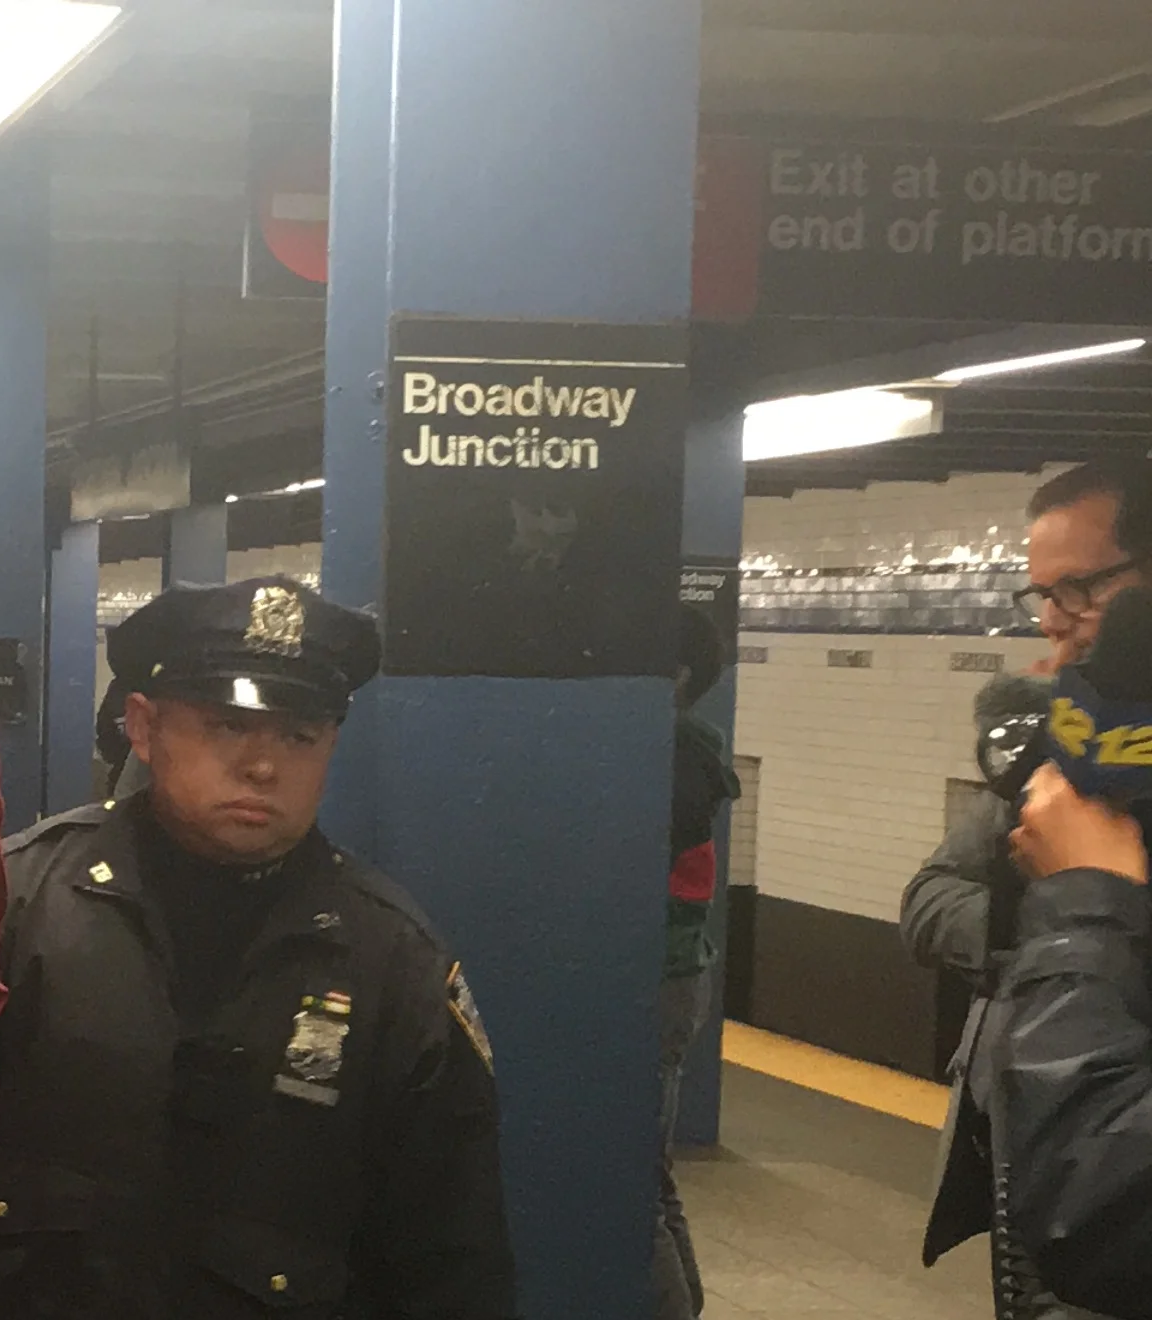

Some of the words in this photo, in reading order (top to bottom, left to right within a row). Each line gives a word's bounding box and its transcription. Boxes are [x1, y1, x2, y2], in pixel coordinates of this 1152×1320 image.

[769, 147, 870, 197] Exit
[892, 157, 941, 198] at
[964, 157, 1101, 205] other
[767, 205, 866, 251] end
[887, 208, 943, 254] of
[402, 372, 637, 427] Broadway
[401, 424, 599, 469] Junction
